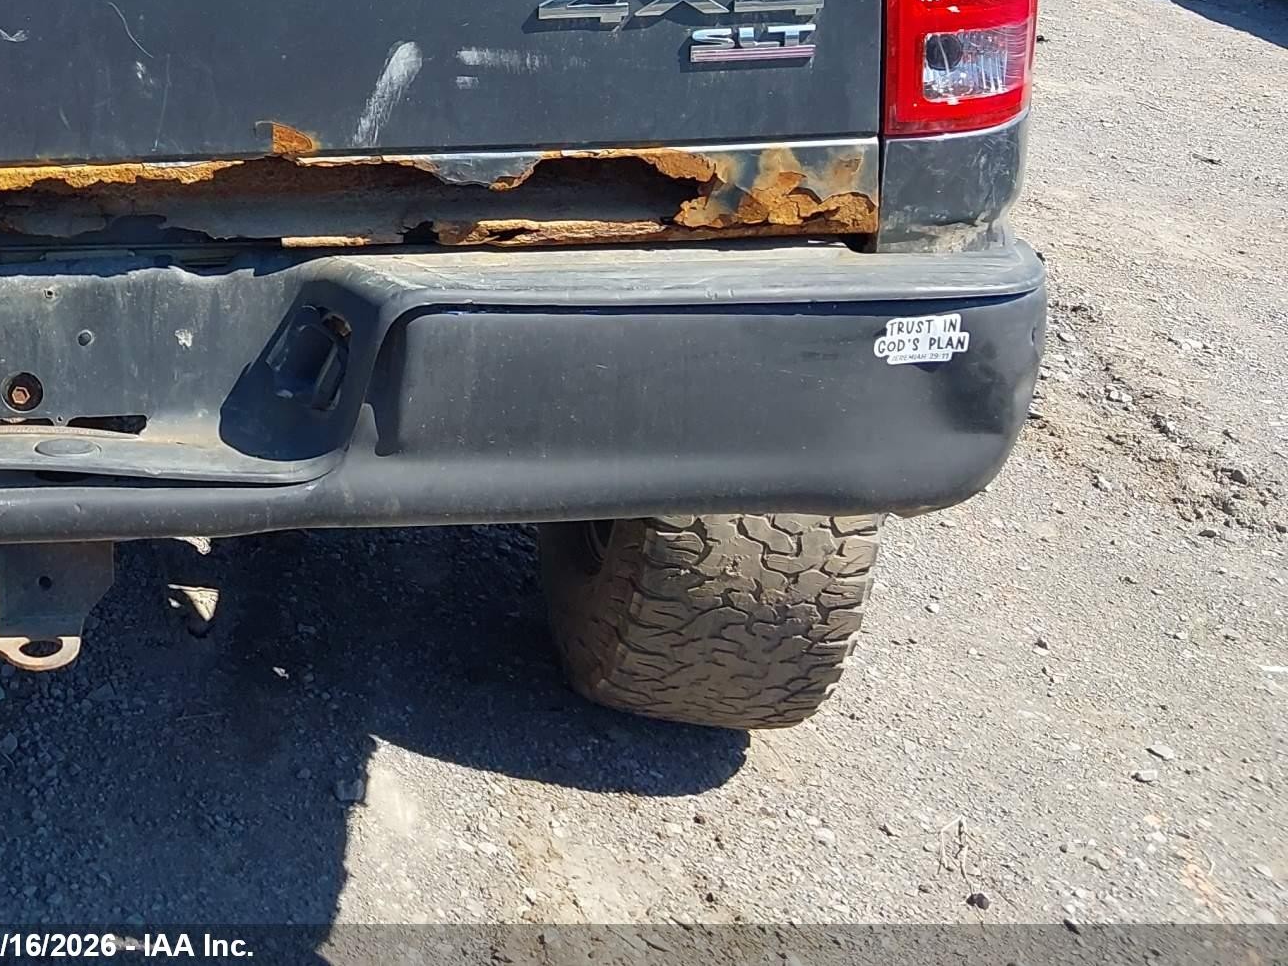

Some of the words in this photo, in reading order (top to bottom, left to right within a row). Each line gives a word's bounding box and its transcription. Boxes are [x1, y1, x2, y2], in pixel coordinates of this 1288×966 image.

[691, 23, 816, 49] SLT
[888, 319, 934, 336] TRUST
[943, 318, 958, 333] IN
[878, 337, 919, 354] GOD'S
[928, 335, 966, 350] PLAN
